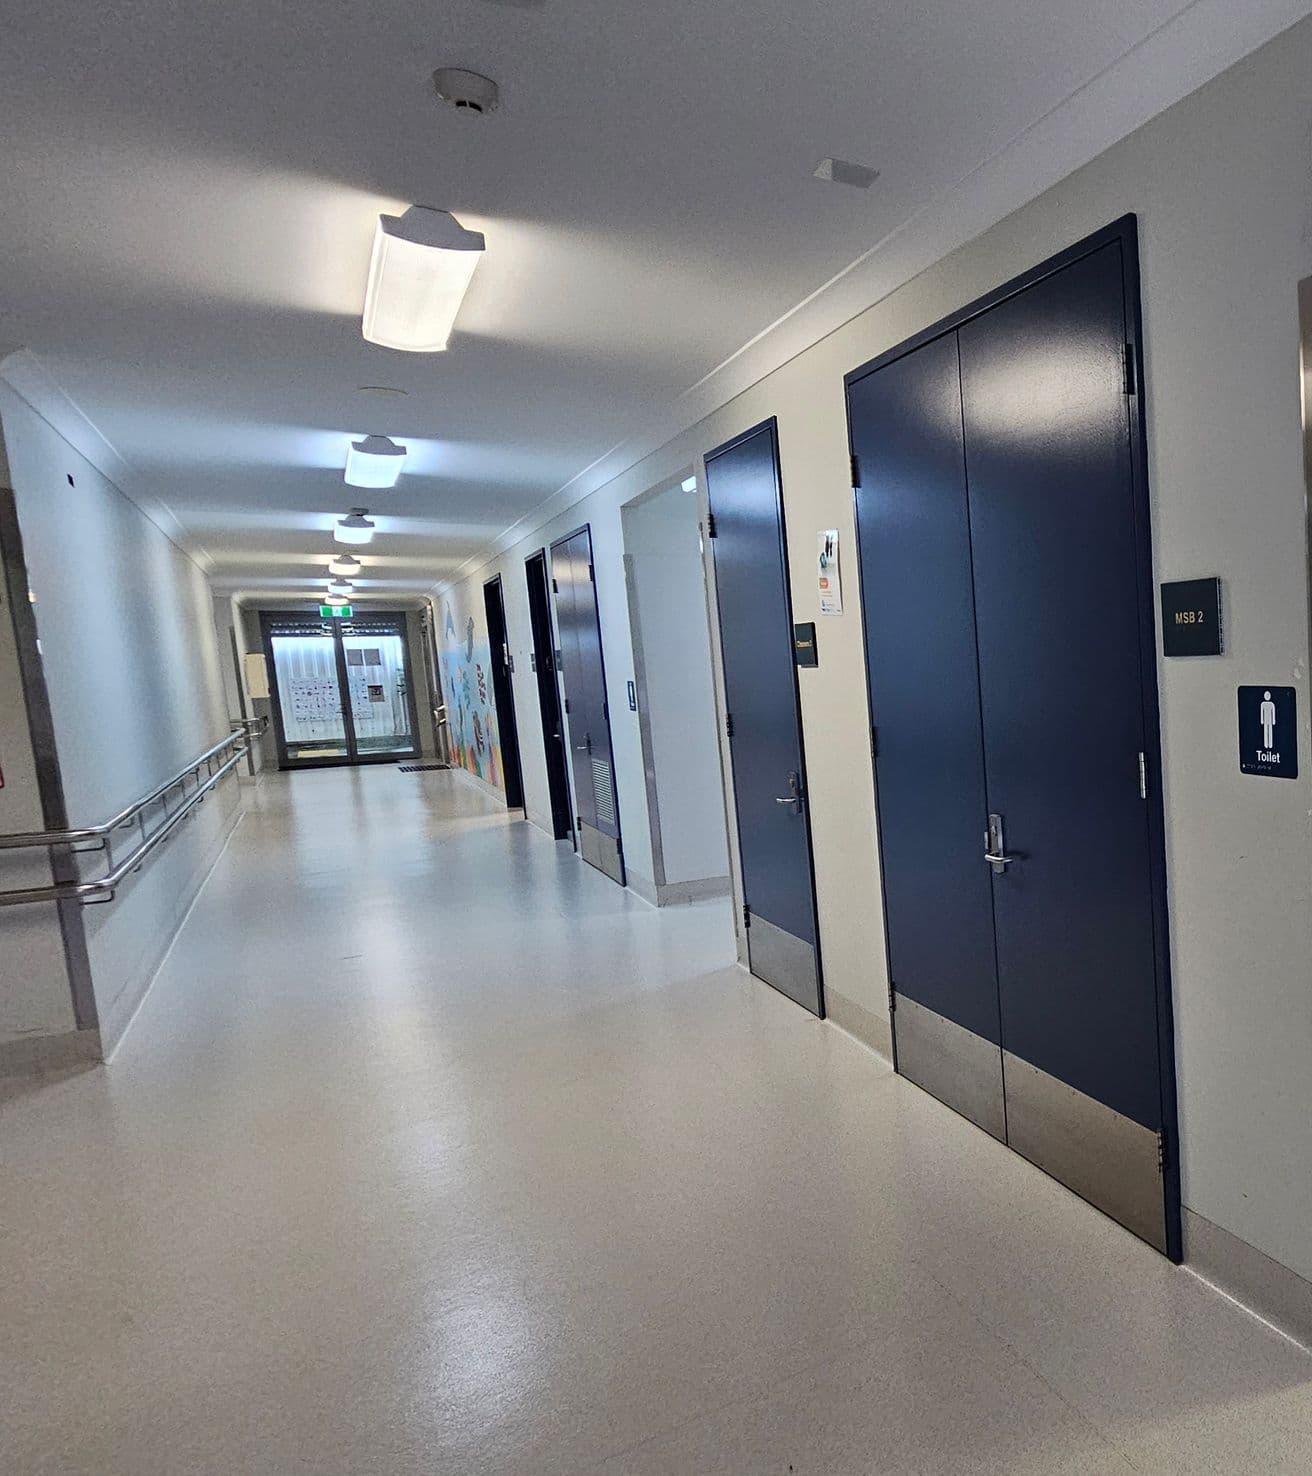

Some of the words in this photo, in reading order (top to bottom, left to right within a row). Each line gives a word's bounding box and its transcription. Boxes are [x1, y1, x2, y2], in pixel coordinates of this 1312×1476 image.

[1175, 611, 1196, 624] MSB
[1197, 610, 1204, 623] 2
[1255, 750, 1281, 763] Toilet
